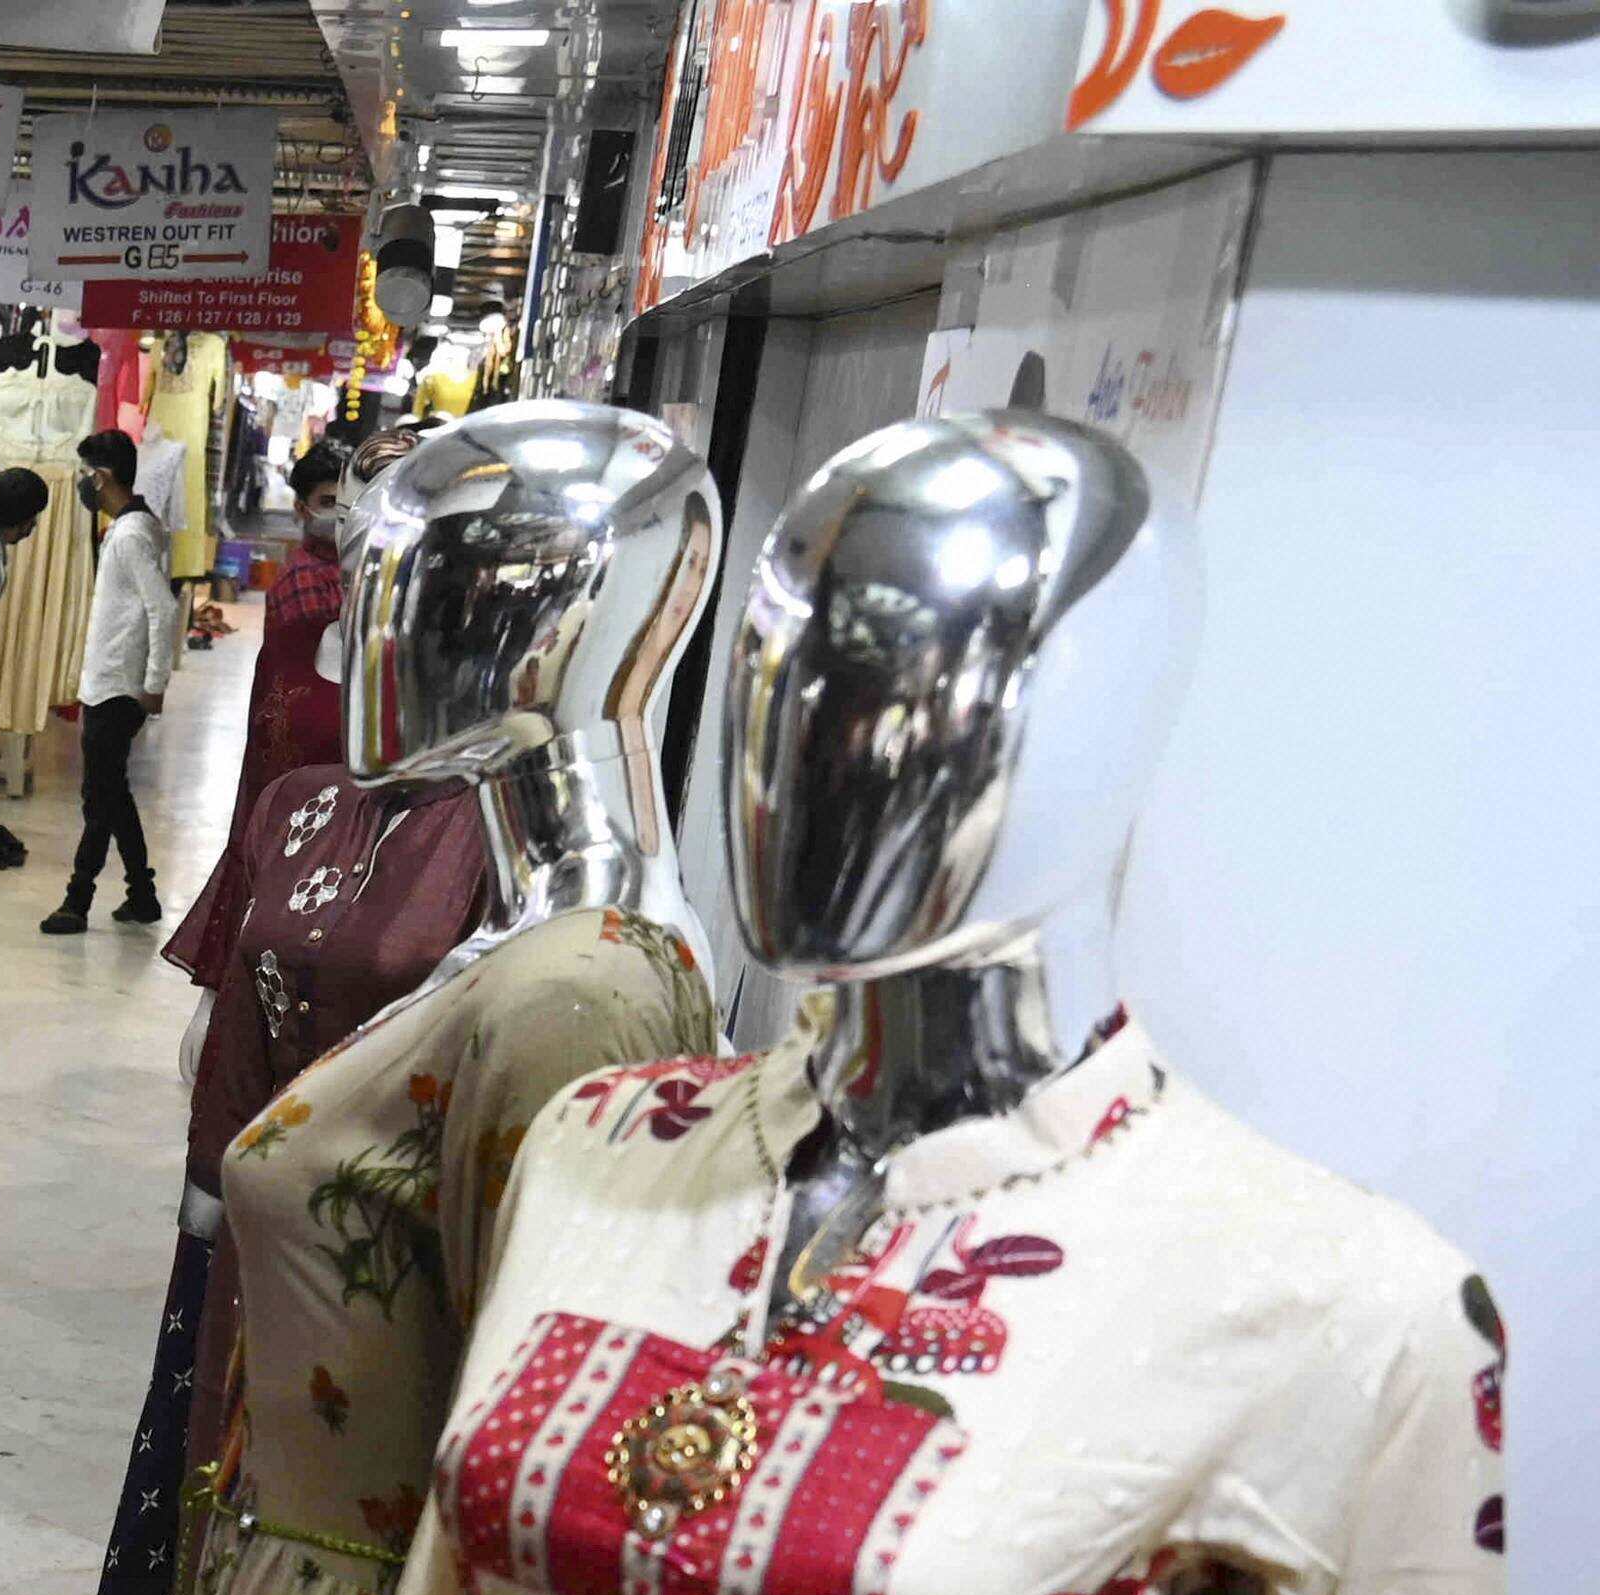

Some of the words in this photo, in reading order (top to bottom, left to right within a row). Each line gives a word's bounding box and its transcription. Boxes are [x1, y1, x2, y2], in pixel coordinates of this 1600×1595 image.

[63, 225, 157, 243] WESTREN
[162, 224, 202, 241] OUT
[207, 223, 236, 241] FIT
[138, 290, 192, 304] Shifted
[198, 291, 215, 304] To
[218, 291, 253, 305] First
[256, 292, 298, 306] Floor
[197, 311, 220, 325] 127
